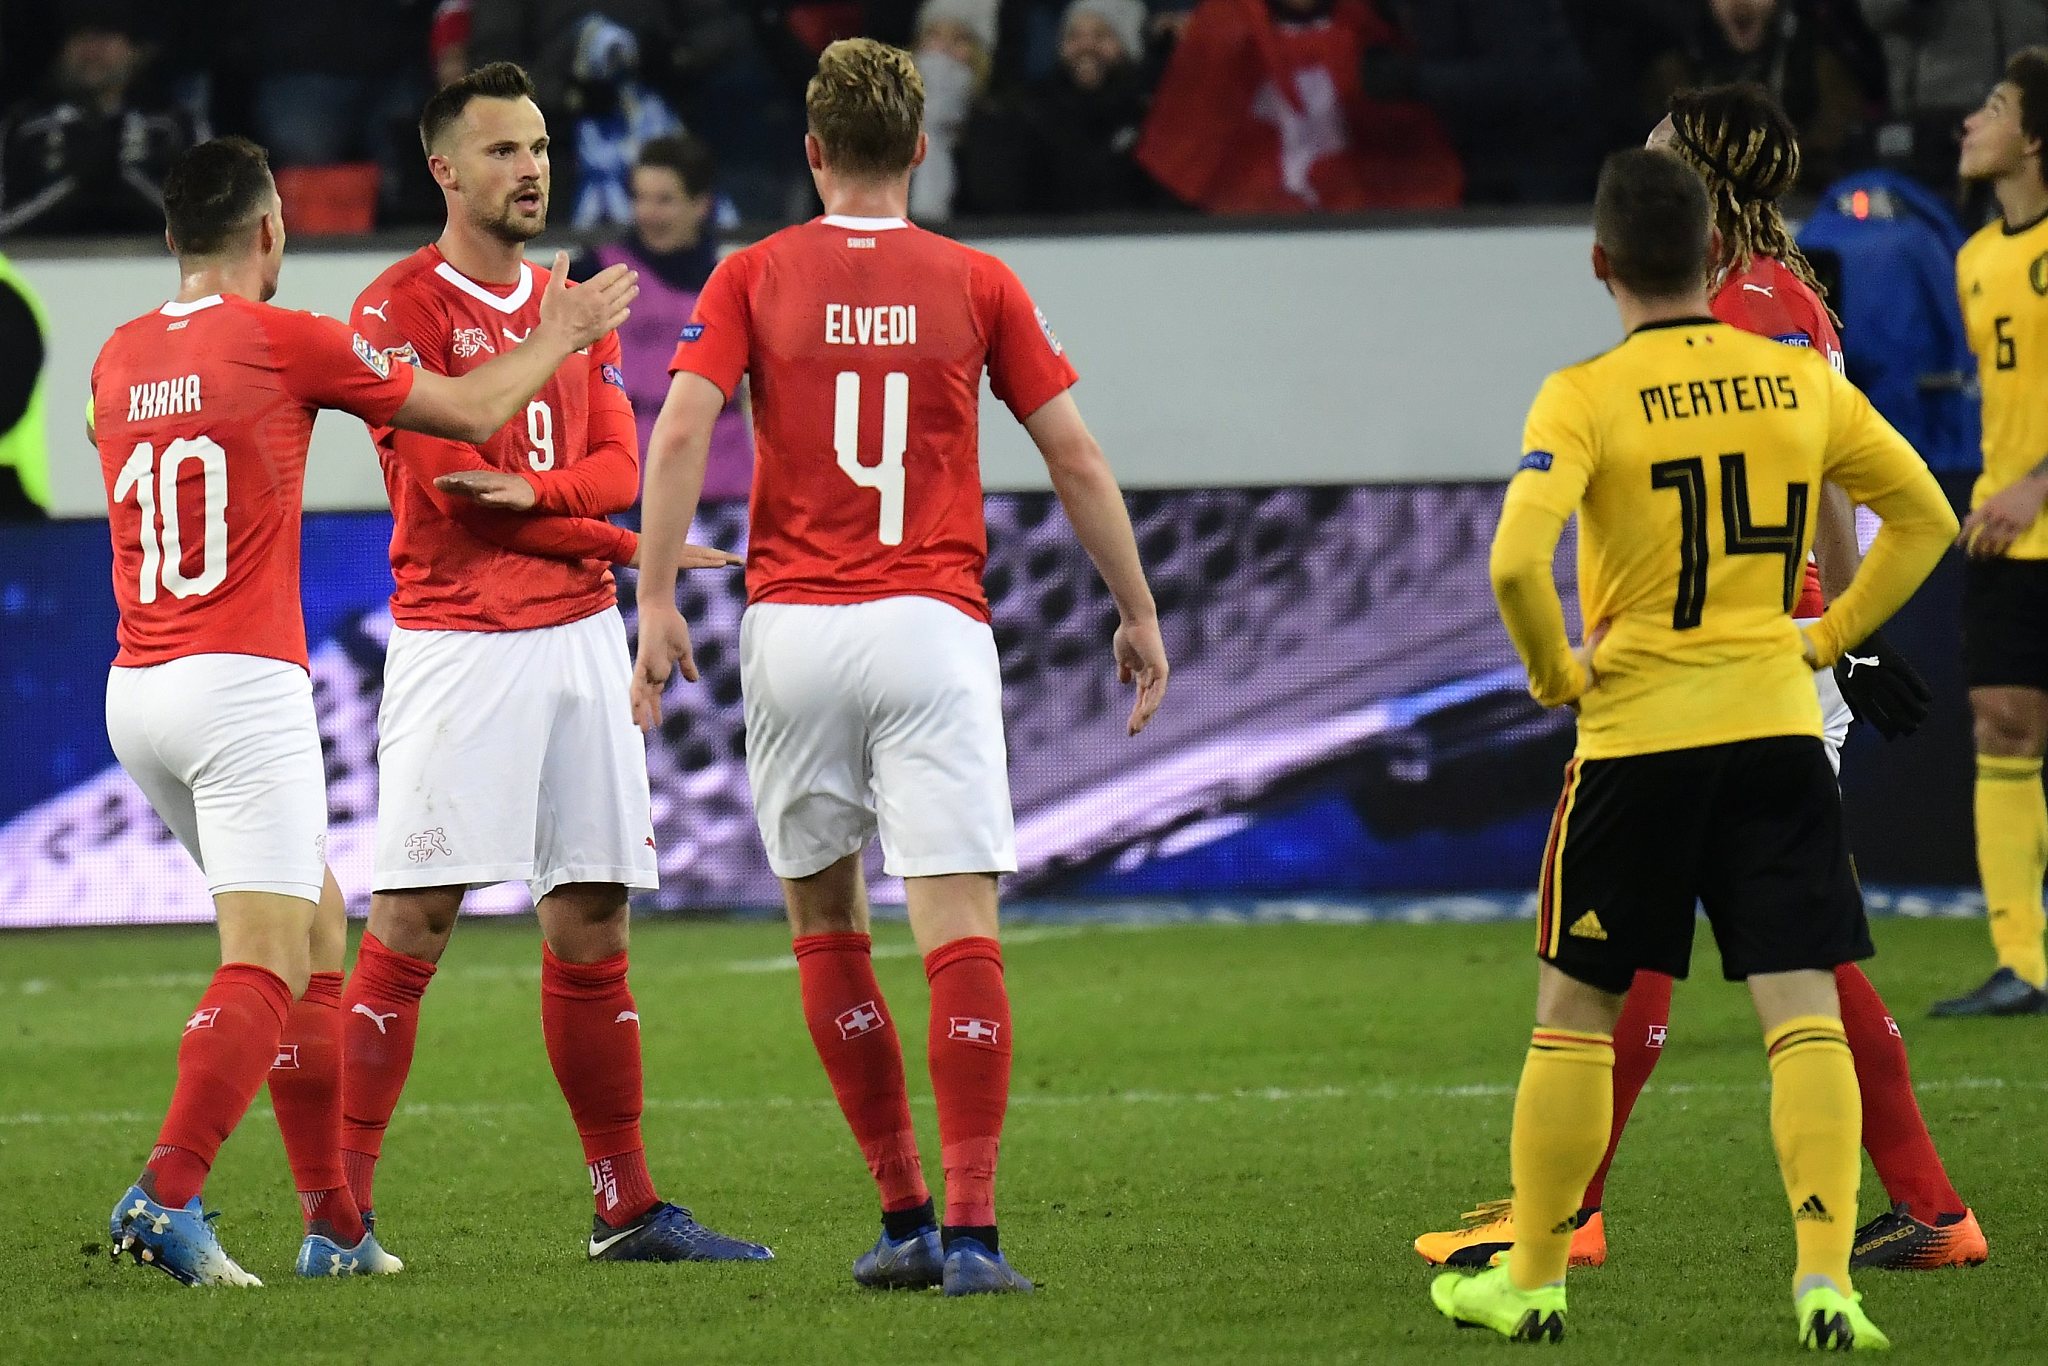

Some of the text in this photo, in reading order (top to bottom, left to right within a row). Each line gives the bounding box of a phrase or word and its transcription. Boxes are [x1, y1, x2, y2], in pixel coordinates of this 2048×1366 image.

[825, 304, 917, 346] ELVEDI
[1994, 316, 2017, 370] 6
[127, 375, 202, 422] XHAKA
[1640, 375, 1798, 423] MERTENS
[526, 400, 555, 472] 9
[833, 371, 909, 547] 4
[113, 435, 229, 603] 10
[1651, 452, 1809, 632] 14
